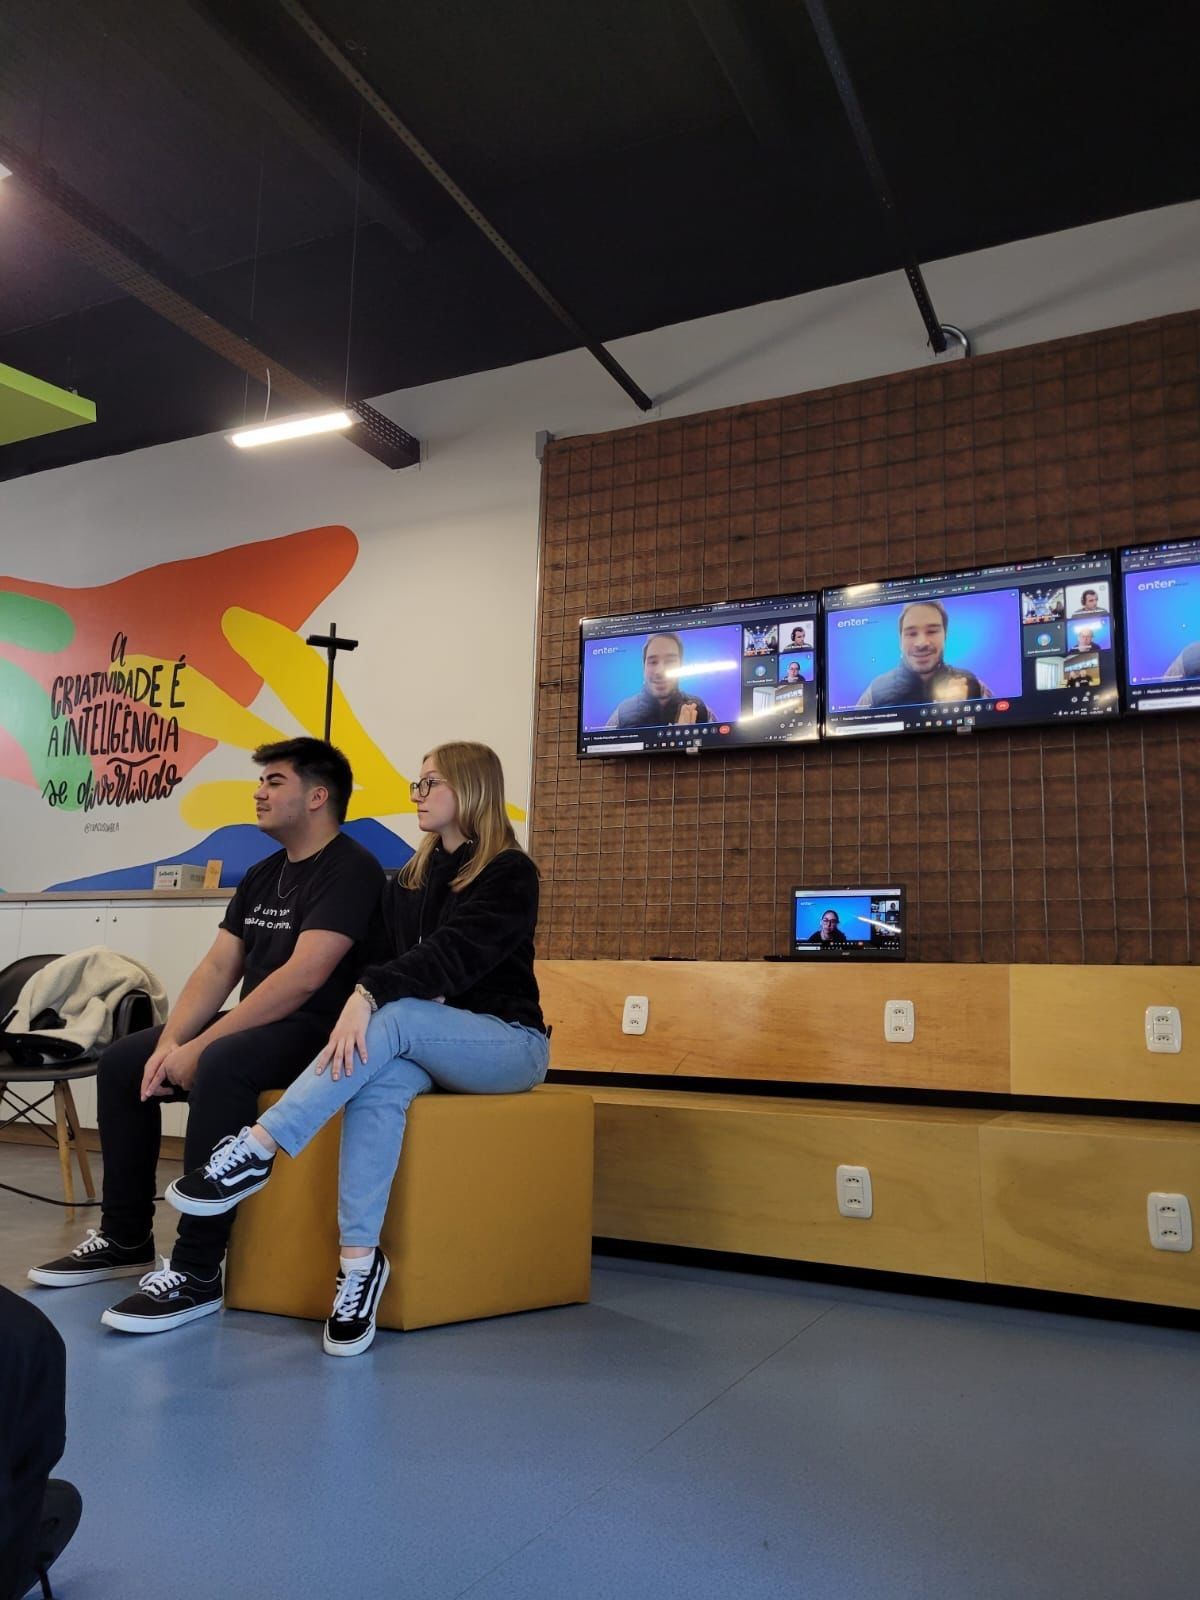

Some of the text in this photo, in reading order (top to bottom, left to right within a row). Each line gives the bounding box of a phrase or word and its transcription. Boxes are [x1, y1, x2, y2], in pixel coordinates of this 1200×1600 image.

[1138, 579, 1176, 591] enter
[837, 618, 868, 628] enter
[592, 647, 618, 656] enter
[51, 654, 187, 720] CRIATIVIDADE É
[47, 698, 179, 758] A INTELIGÊNCIA
[41, 779, 68, 807] se
